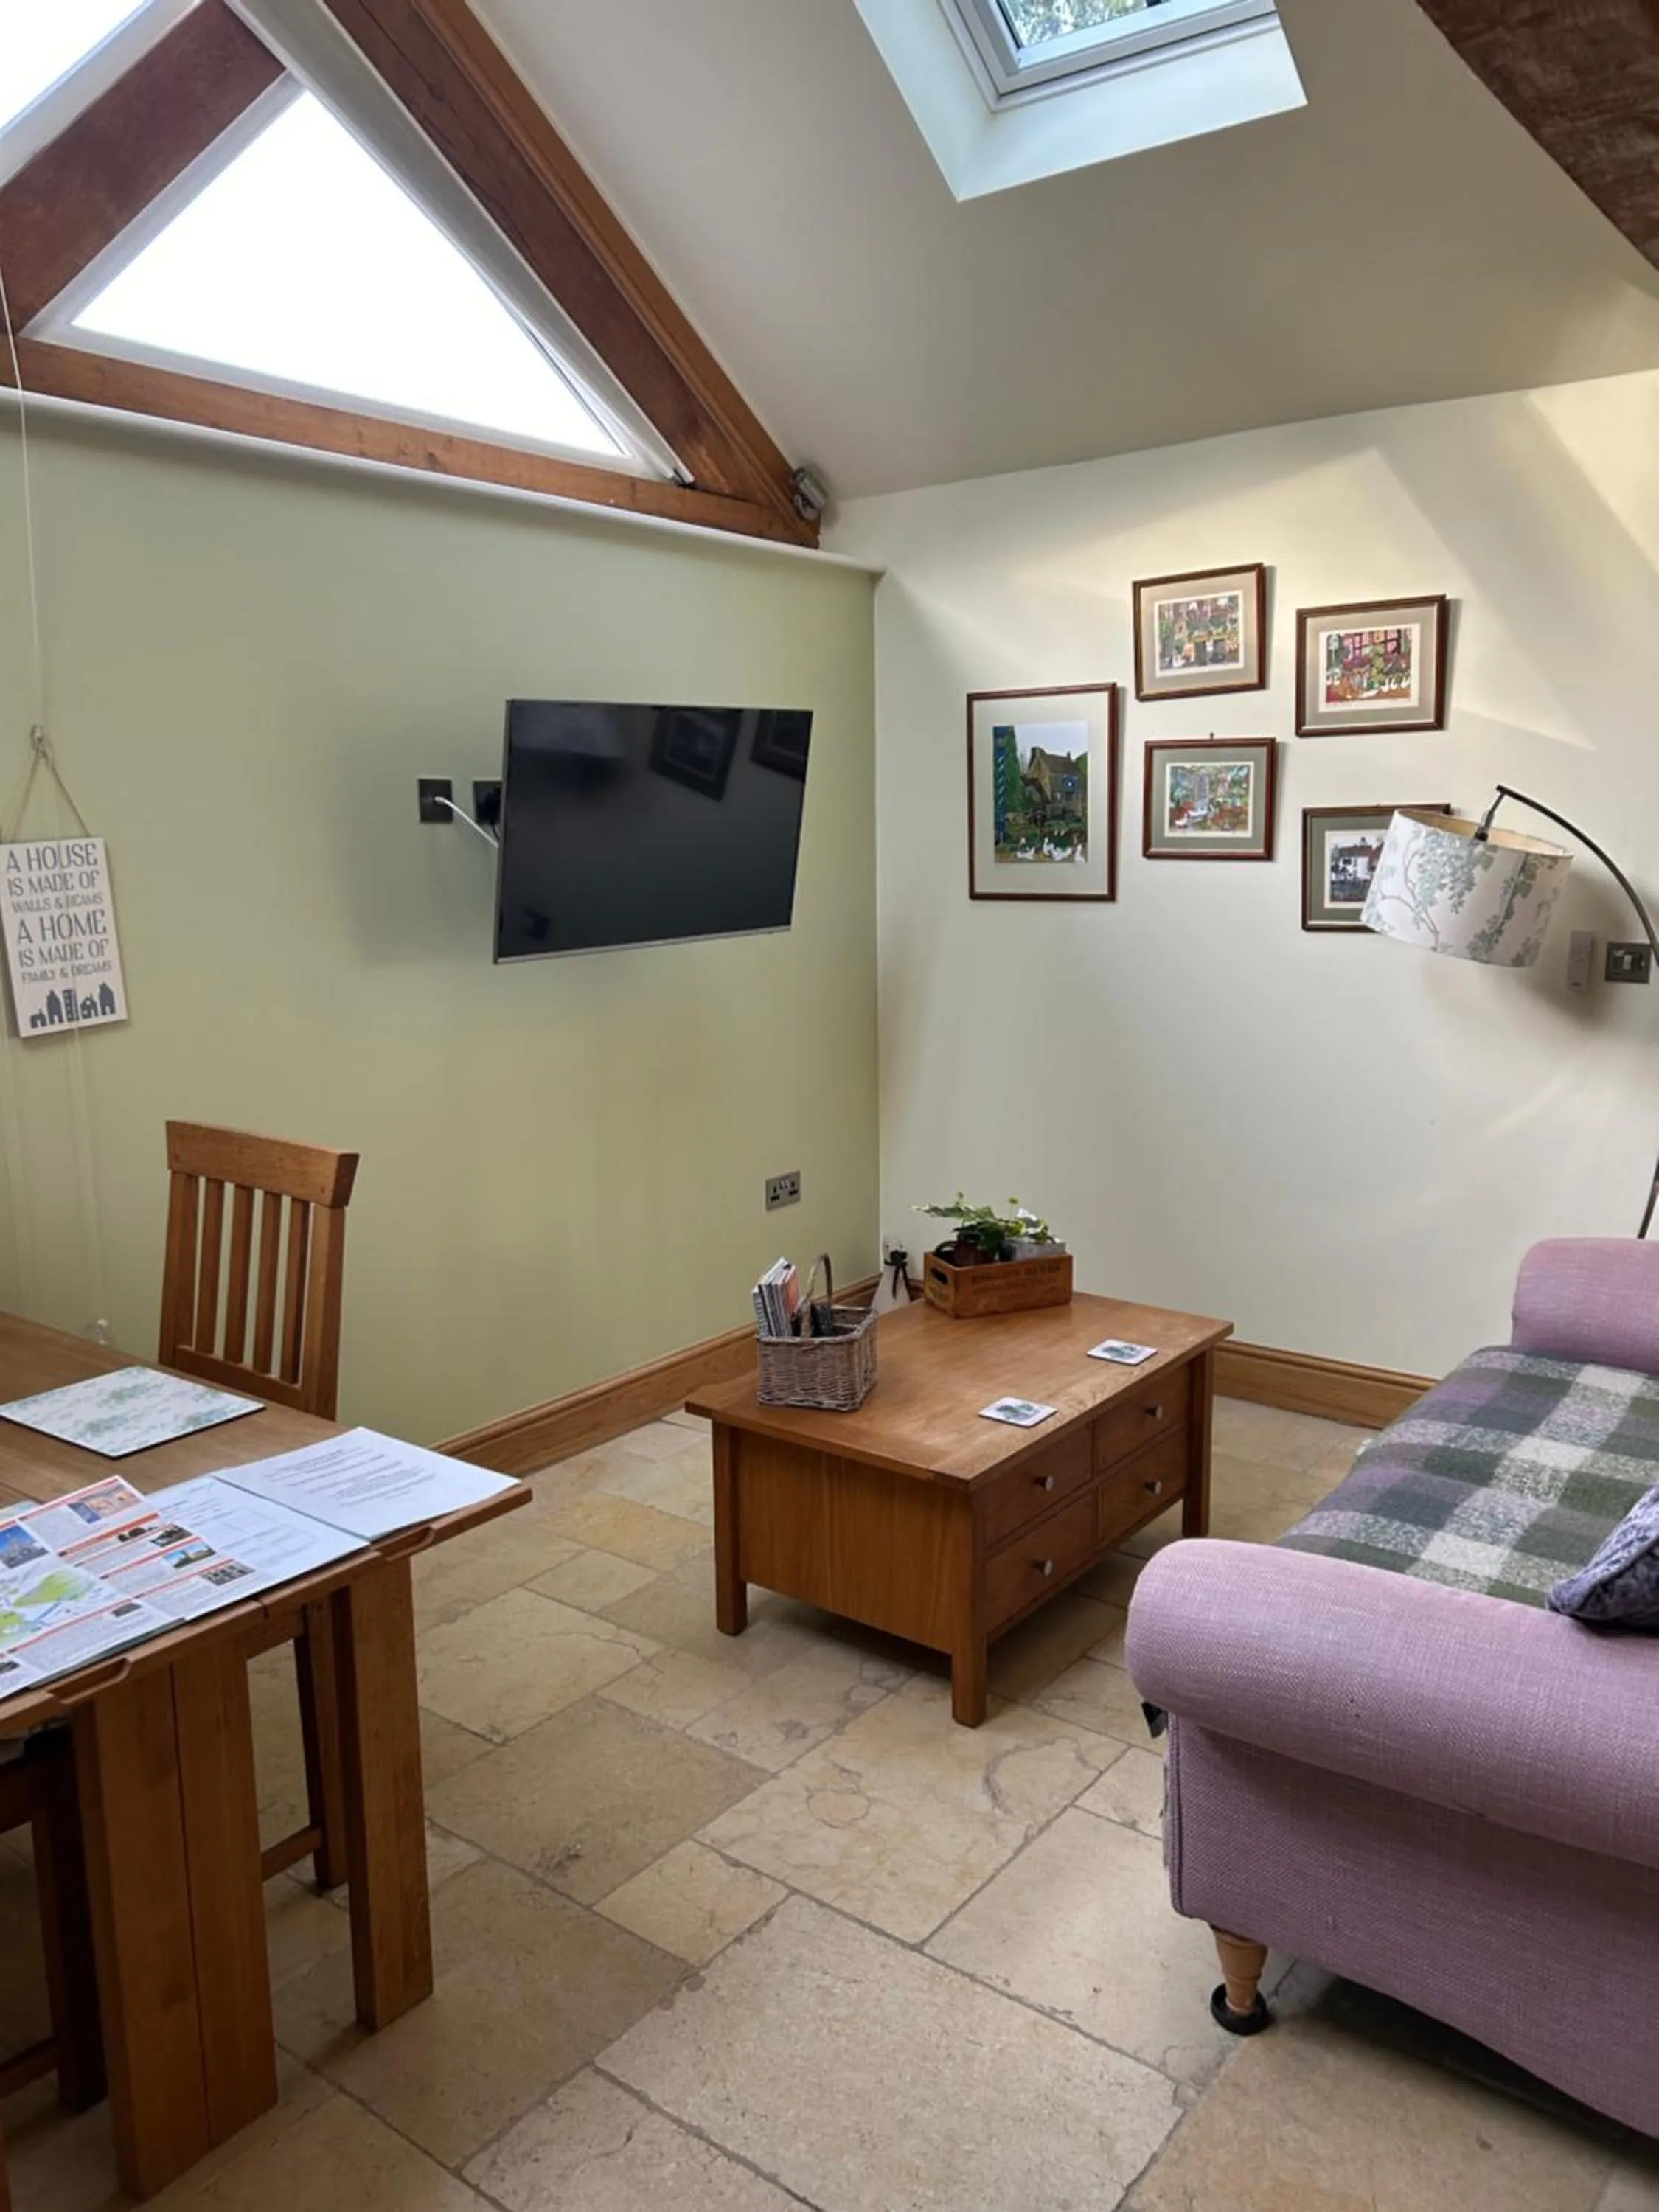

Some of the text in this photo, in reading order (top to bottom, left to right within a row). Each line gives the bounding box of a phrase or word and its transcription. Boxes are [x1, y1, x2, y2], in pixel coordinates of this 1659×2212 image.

[7, 843, 98, 873] A HOUSE
[7, 870, 100, 897] IS MADE OF
[12, 897, 52, 914] WALLS
[54, 897, 63, 909] &
[18, 908, 107, 944] A HOME
[18, 938, 109, 968] IS MADE OF
[59, 967, 69, 979] &
[71, 960, 113, 977] DREAMS
